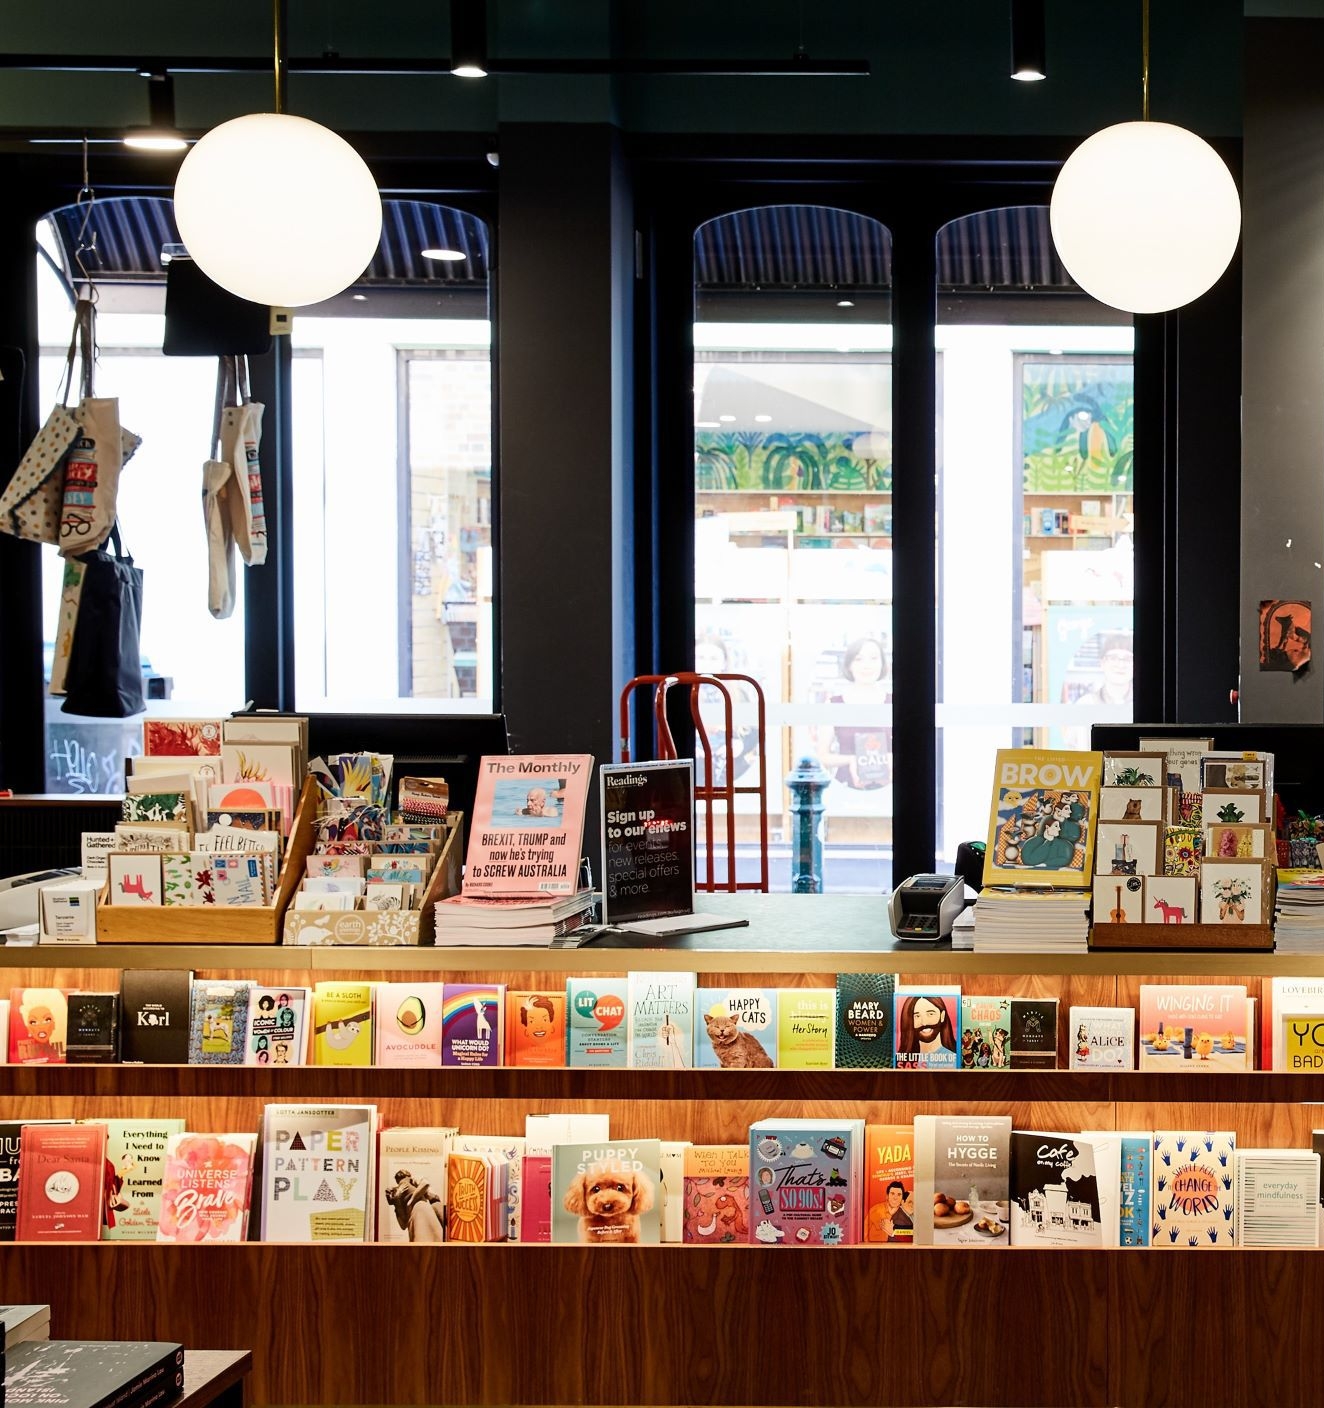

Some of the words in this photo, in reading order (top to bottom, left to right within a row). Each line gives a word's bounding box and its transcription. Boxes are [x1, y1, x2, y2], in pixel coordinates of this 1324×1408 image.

[487, 762, 515, 774] The
[518, 762, 581, 775] Monthly
[1000, 762, 1094, 787] BROW
[606, 774, 648, 787] Readings
[607, 811, 636, 825] Sign
[638, 809, 655, 821] up
[607, 827, 622, 839] to
[624, 825, 645, 837] our
[648, 820, 687, 834] enews
[214, 836, 235, 851] FEEL
[482, 833, 516, 846] BREXIT,
[518, 833, 549, 845] TRUMP
[550, 833, 567, 845] and
[608, 840, 624, 853] for
[489, 850, 508, 861] now
[509, 848, 526, 861] he's
[528, 849, 554, 863] trying
[608, 857, 632, 868] new
[472, 866, 482, 877] to
[484, 865, 517, 877] SCREW
[518, 864, 567, 877] AUSTRALIA
[608, 866, 647, 883] special
[650, 864, 680, 878] offers
[608, 885, 618, 898] &
[340, 920, 361, 929] earth
[645, 984, 678, 1001] ART
[578, 997, 594, 1007] LIT
[634, 1001, 689, 1016] MATTERS
[729, 998, 760, 1012] HAPPY
[797, 1001, 816, 1010] this
[853, 1001, 880, 1010] MARY
[1156, 994, 1215, 1012] WINGING
[1219, 994, 1233, 1012] IT
[596, 1006, 623, 1016] CHAT
[742, 1011, 766, 1024] CATS
[848, 1010, 884, 1019] BEARD
[971, 1009, 1001, 1021] CHAOS
[896, 1053, 908, 1061] THE
[909, 1053, 928, 1061] LITTLE
[930, 1053, 947, 1061] BOOK
[948, 1053, 957, 1062] OF
[123, 1130, 168, 1139] Everything
[275, 1130, 360, 1152] PAPER
[385, 1145, 410, 1153] PEOPLE
[582, 1148, 639, 1162] PUPPY
[877, 1144, 911, 1165] YADA
[947, 1147, 997, 1160] HYGGE
[1036, 1143, 1078, 1161] Cafe
[137, 1154, 160, 1162] Know
[1044, 1160, 1054, 1168] my
[275, 1158, 360, 1173] PATTERN
[577, 1161, 643, 1175] STYLED
[1172, 1165, 1197, 1178] SIMPLE
[1199, 1164, 1217, 1178] ACTS
[178, 1169, 237, 1178] UNIVERSE
[775, 1163, 826, 1191] That's
[127, 1178, 162, 1186] Learned
[181, 1179, 231, 1189] LISTENS
[1174, 1178, 1213, 1192] CHANGE
[1262, 1182, 1298, 1192] everyday
[132, 1190, 154, 1198] From
[274, 1176, 358, 1202] PLAY
[457, 1183, 476, 1196] TRUTH
[1257, 1190, 1303, 1200] mindfulness
[781, 1188, 797, 1209] SO
[1169, 1193, 1220, 1217] WORLD
[175, 1188, 235, 1228] Brave
